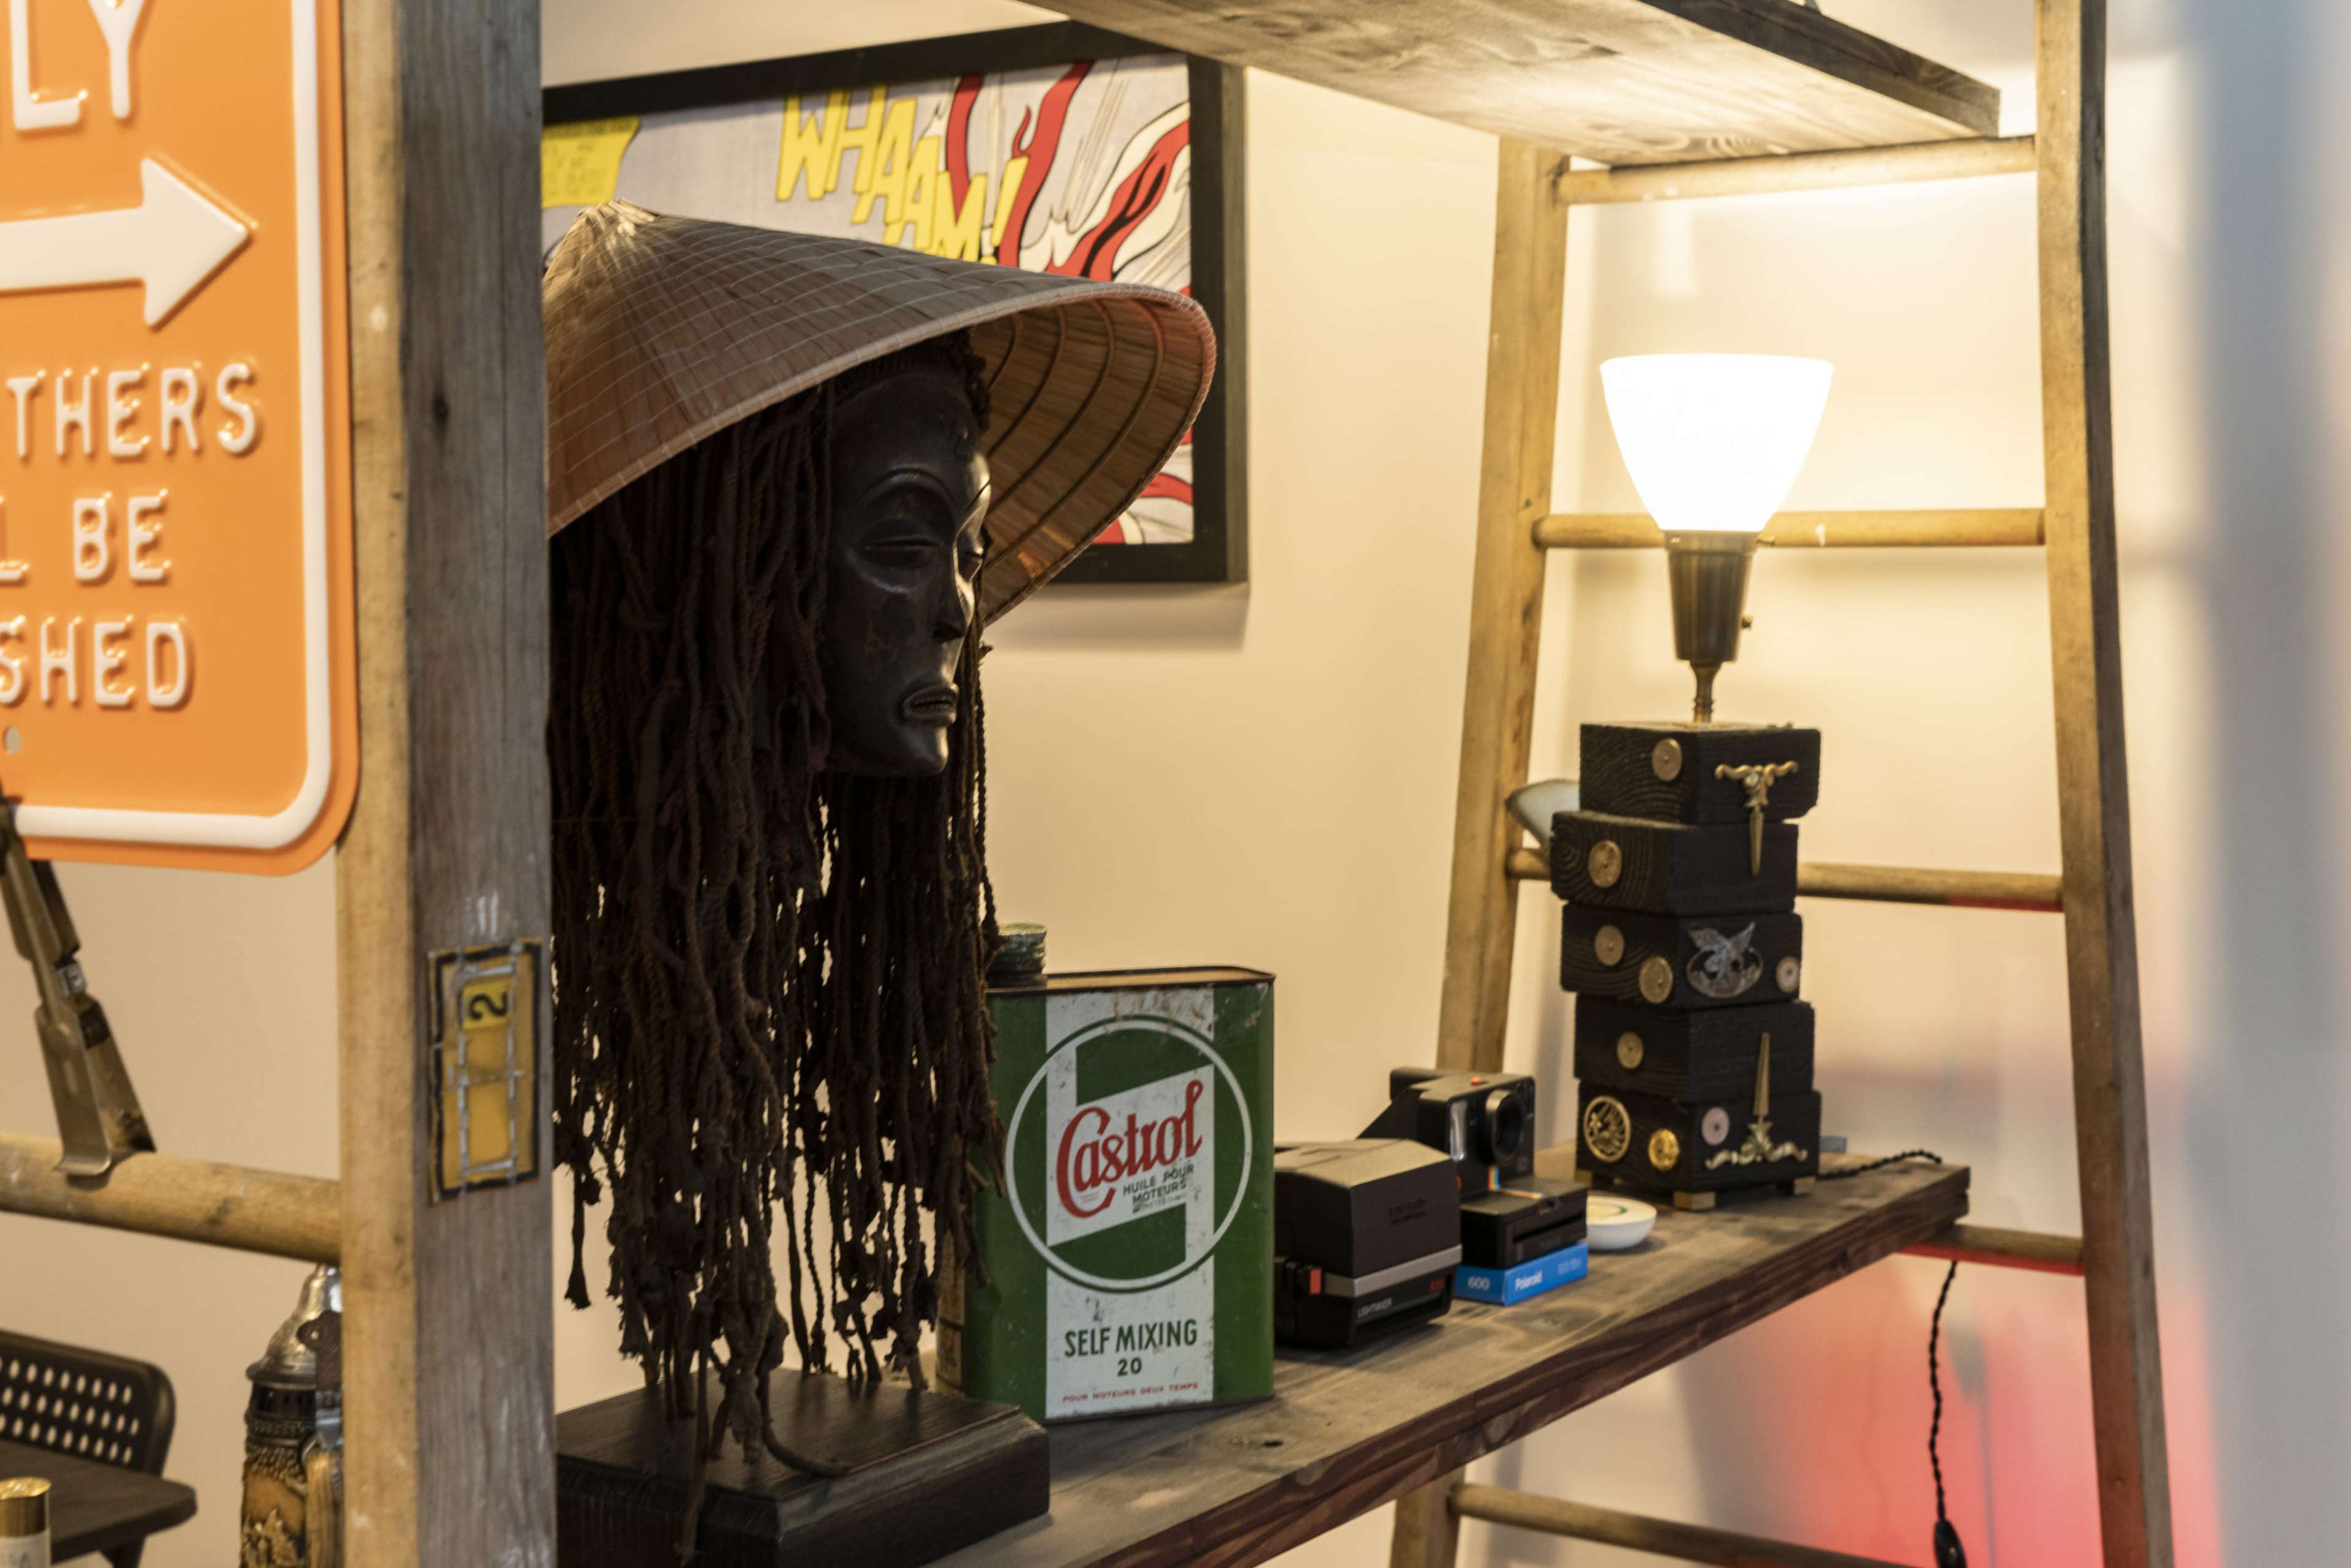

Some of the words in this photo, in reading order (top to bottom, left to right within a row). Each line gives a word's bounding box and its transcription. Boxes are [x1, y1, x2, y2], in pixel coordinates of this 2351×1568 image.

[9, 0, 148, 131] LY
[776, 82, 1030, 265] WHAAM!
[6, 362, 257, 457] THERS
[73, 490, 170, 581] BE
[1056, 1079, 1204, 1218] Castrol
[1123, 1175, 1157, 1196] HUILE
[1163, 1163, 1194, 1182] POUR
[1131, 1177, 1187, 1205] MOTEURS
[1467, 1275, 1490, 1291] 600
[1064, 1326, 1111, 1358] SELF
[1115, 1318, 1198, 1353] MIXING
[1117, 1357, 1143, 1377] 20
[1062, 1394, 1089, 1402] POUR
[1092, 1388, 1136, 1400] MOTEURS
[1139, 1385, 1164, 1395] DEUX
[1169, 1381, 1199, 1392] TEMPS
